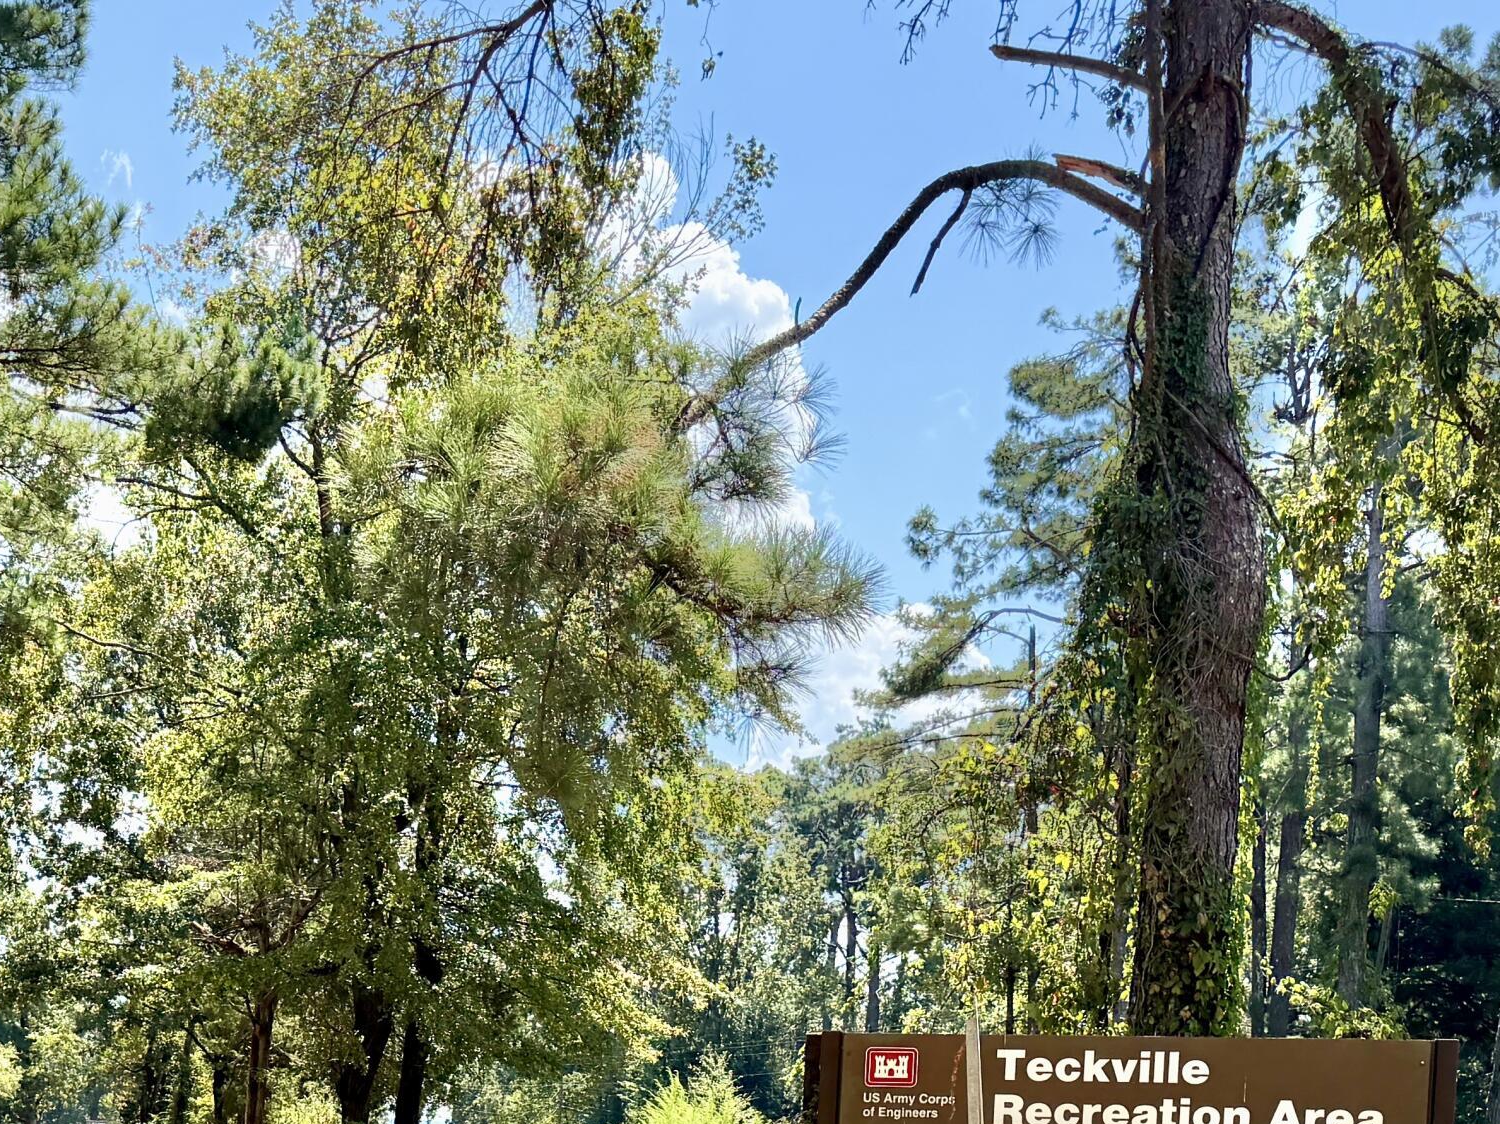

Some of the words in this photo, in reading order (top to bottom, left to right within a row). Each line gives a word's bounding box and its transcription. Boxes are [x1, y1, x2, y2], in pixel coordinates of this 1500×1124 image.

[996, 1049, 1210, 1085] Teckville
[863, 1092, 880, 1103] US
[883, 1092, 916, 1106] Army
[918, 1093, 956, 1107] Corps
[862, 1106, 876, 1117] of
[878, 1107, 939, 1120] Engineers
